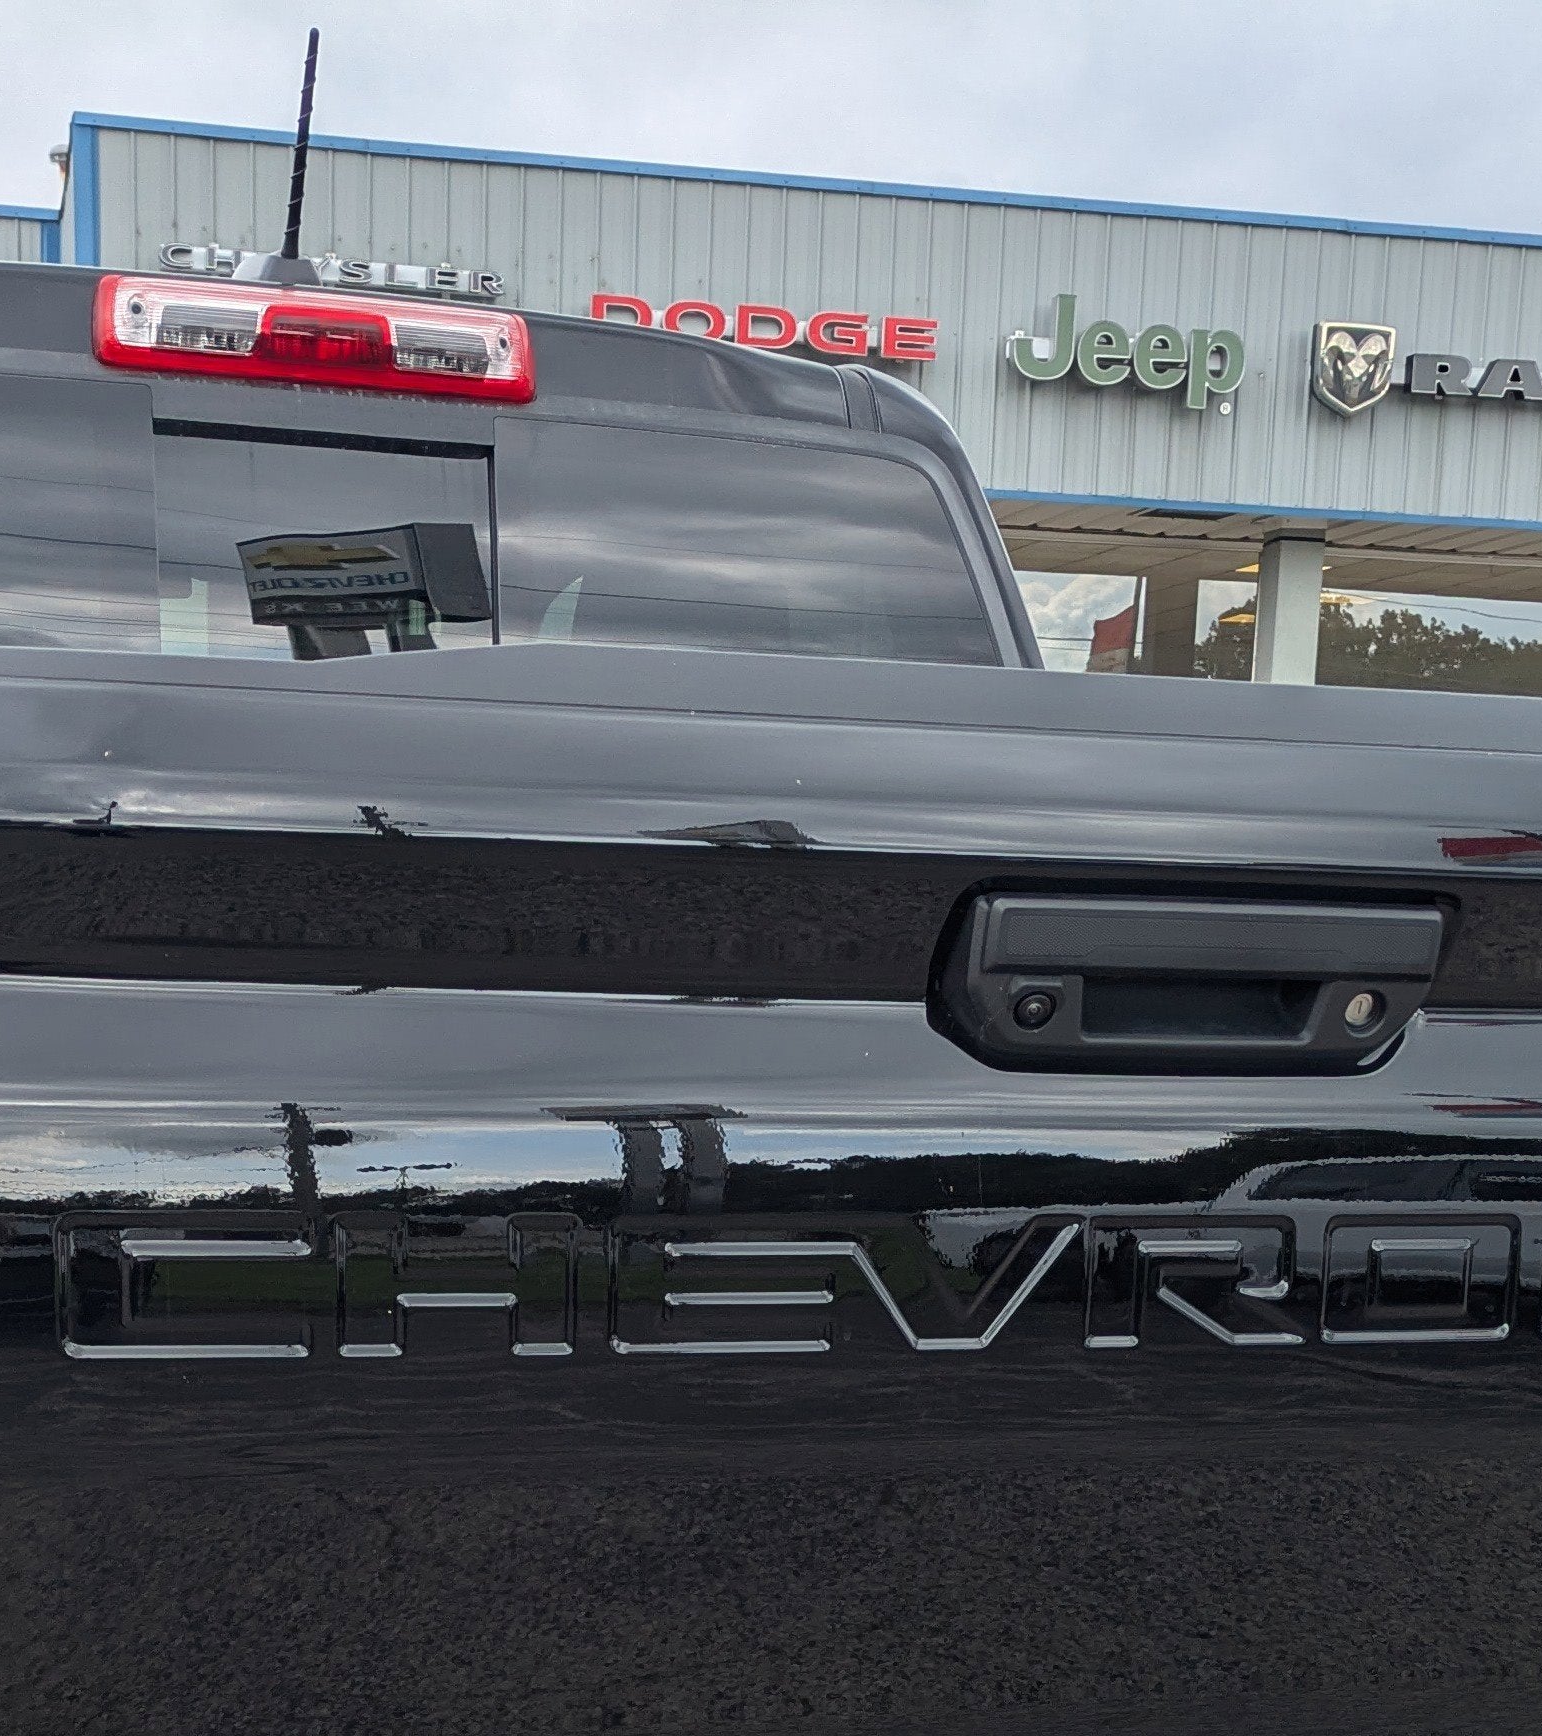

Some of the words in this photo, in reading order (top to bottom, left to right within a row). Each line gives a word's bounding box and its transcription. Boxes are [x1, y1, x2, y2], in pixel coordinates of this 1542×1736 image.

[160, 243, 505, 294] CHYSLER
[590, 292, 940, 361] DODGE
[1011, 293, 1246, 409] Jeep
